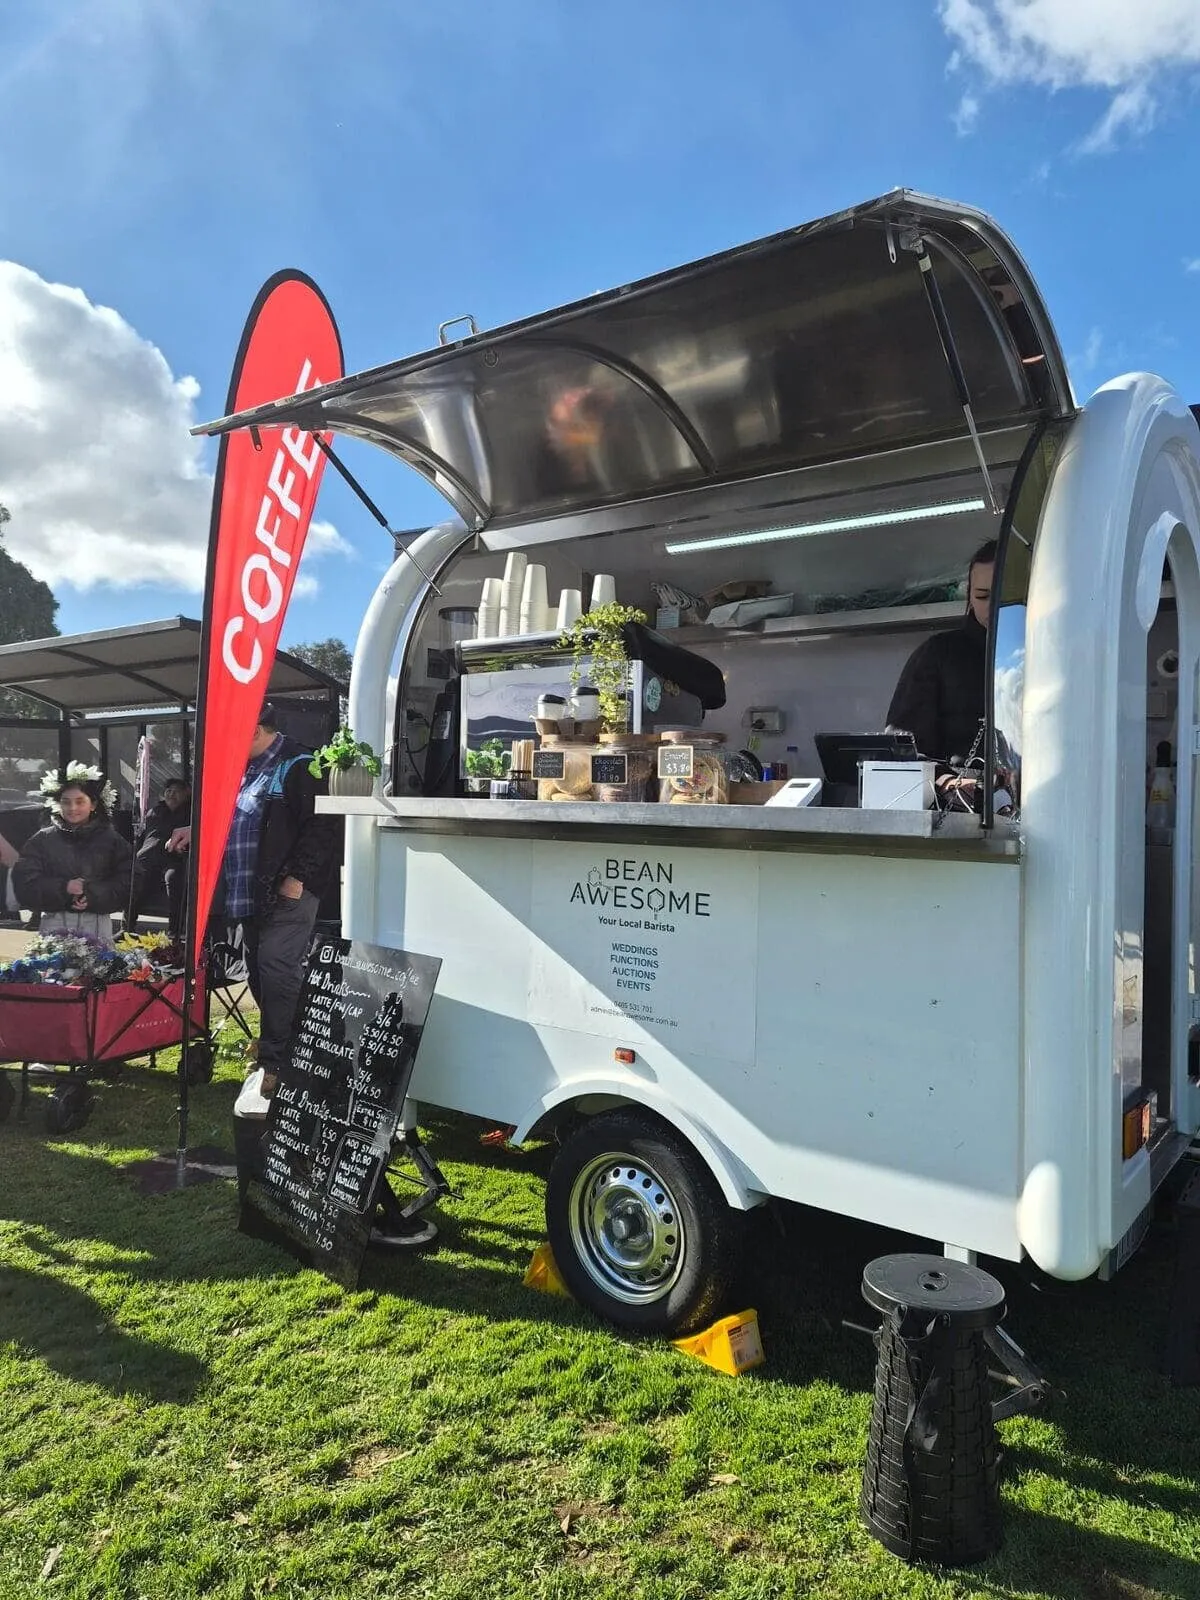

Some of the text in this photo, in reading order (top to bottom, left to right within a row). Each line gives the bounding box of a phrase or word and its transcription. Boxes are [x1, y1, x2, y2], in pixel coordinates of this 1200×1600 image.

[606, 859, 673, 883] BEAN
[570, 882, 711, 917] AWESOME
[598, 916, 675, 932] Your Local Barista
[612, 943, 658, 956] WEDDINGS
[610, 955, 659, 968] FUNCTIONS
[307, 969, 321, 987] Hot
[612, 967, 656, 980] AUCTIONS
[617, 979, 651, 991] EVENTS
[308, 1006, 331, 1023] MOCHA
[304, 1020, 331, 1038] MATCHA
[296, 1047, 313, 1059] CHAI
[301, 1033, 315, 1045] HOT
[316, 1038, 355, 1060] CHOCOLATE
[314, 1065, 332, 1079] CHAI
[276, 1082, 297, 1104] Iced
[282, 1107, 301, 1122] LATTE
[280, 1119, 300, 1137] MOCHA
[345, 1138, 359, 1150] ADD
[268, 1159, 291, 1176] MATCHA
[335, 1171, 360, 1191] Vanilla
[285, 1180, 310, 1200] MATCHA
[290, 1199, 318, 1222] MATCHA
